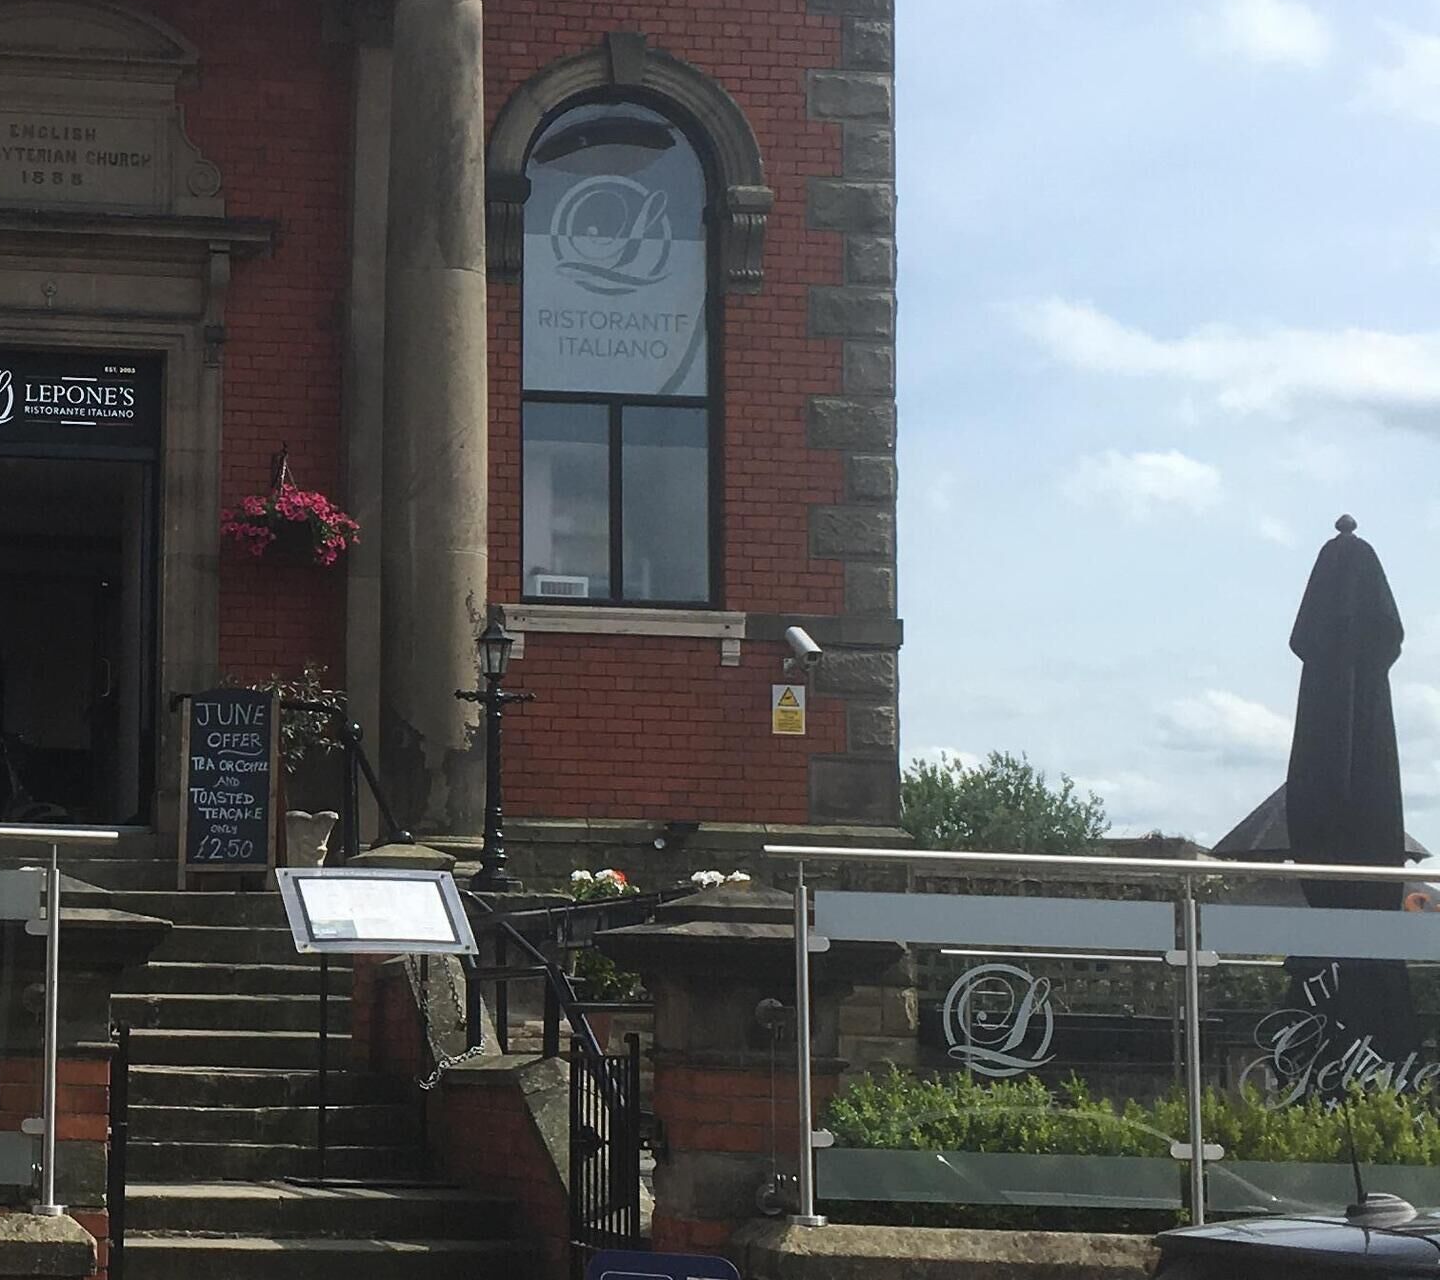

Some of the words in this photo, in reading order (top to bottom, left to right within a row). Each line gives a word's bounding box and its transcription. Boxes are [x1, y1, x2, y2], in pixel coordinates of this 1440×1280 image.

[9, 123, 97, 141] ENGLISH
[85, 150, 152, 168] CHURCH
[537, 308, 689, 333] RISTORANTE
[558, 336, 669, 360] ITALIANO
[25, 384, 135, 406] LEPONE'S
[24, 406, 86, 417] RISTORANTE
[87, 407, 135, 419] ITALIANO
[195, 702, 265, 726] JUNE
[207, 732, 262, 748] OFFER
[191, 756, 215, 771] TEA
[213, 776, 240, 788] AND
[190, 787, 255, 805] TOASTED
[198, 807, 263, 820] TEACAKE
[210, 824, 238, 835] ONLY
